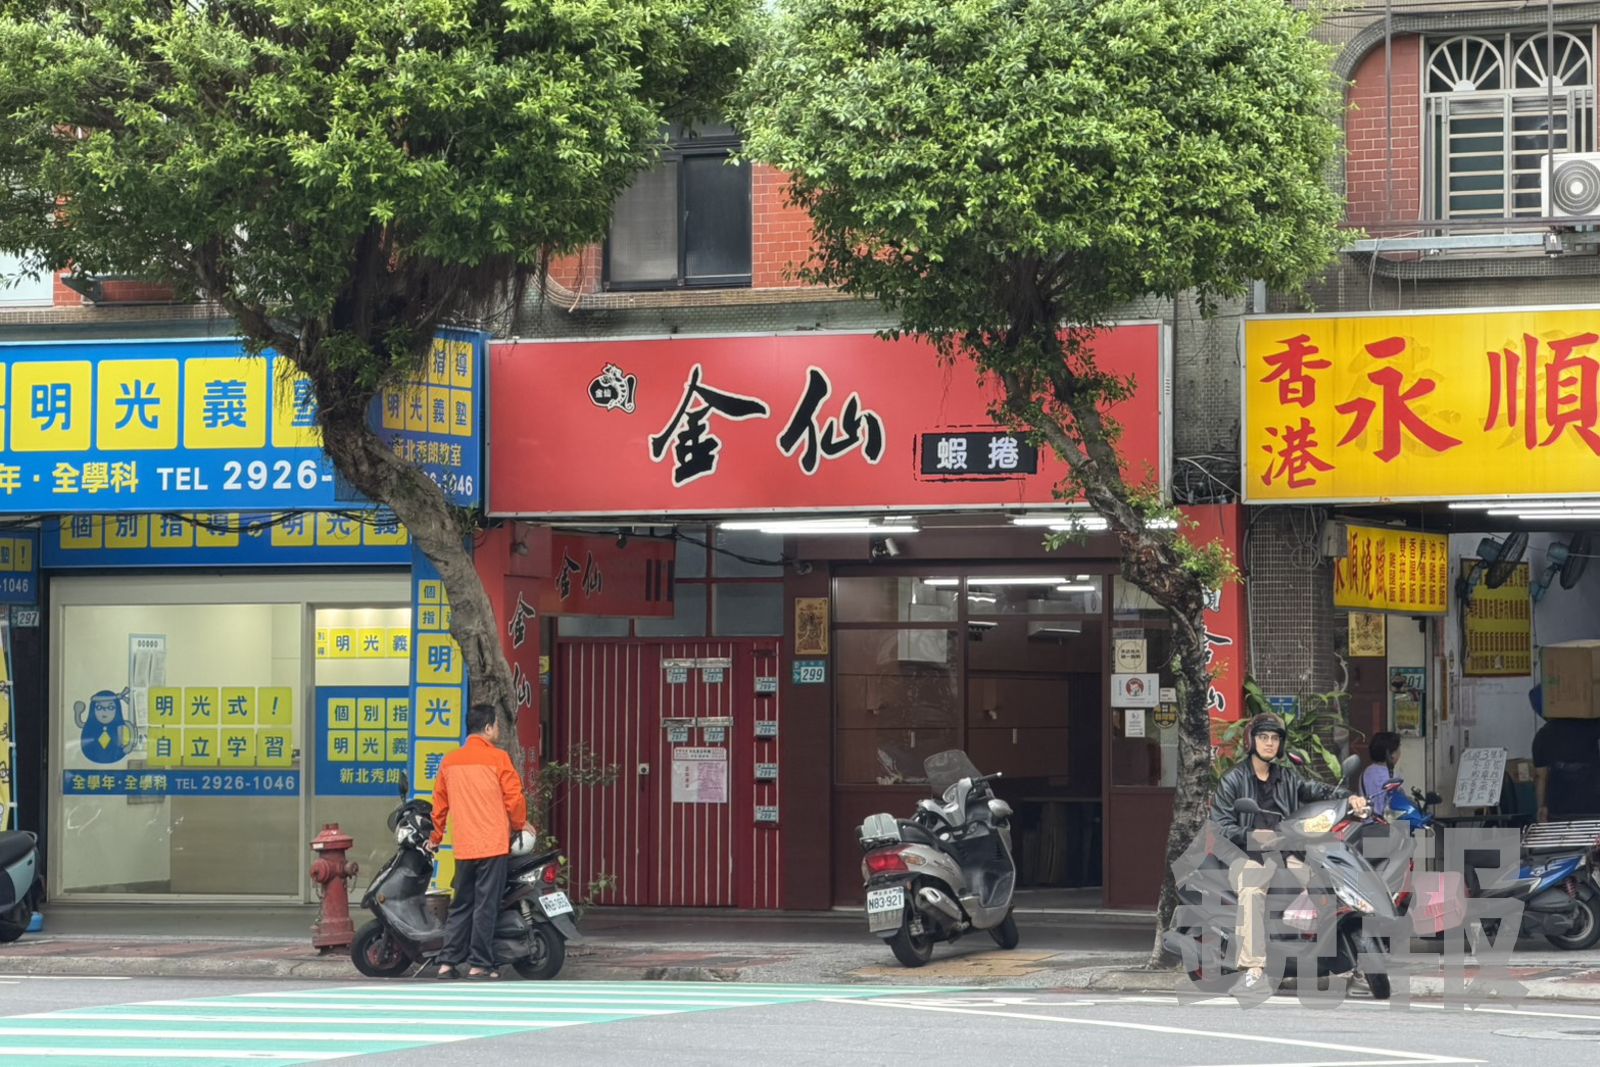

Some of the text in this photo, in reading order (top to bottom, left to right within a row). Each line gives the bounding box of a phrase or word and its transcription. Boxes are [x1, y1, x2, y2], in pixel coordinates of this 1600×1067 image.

[1335, 333, 1600, 463] 永順
[1260, 334, 1336, 488] 香港
[648, 363, 886, 487] 金仙
[936, 435, 1020, 471] 蝦捲
[157, 467, 209, 491] TEL
[555, 548, 604, 601] 金仙
[18, 611, 39, 626] 297
[335, 634, 408, 652] 明光義
[508, 590, 536, 712] 金仙
[802, 668, 823, 681] 299
[334, 704, 408, 723] 個別指
[156, 735, 284, 758] 自立学習
[333, 737, 408, 755] 明光義
[175, 778, 198, 790] TEL
[202, 775, 296, 791] 2926-1046
